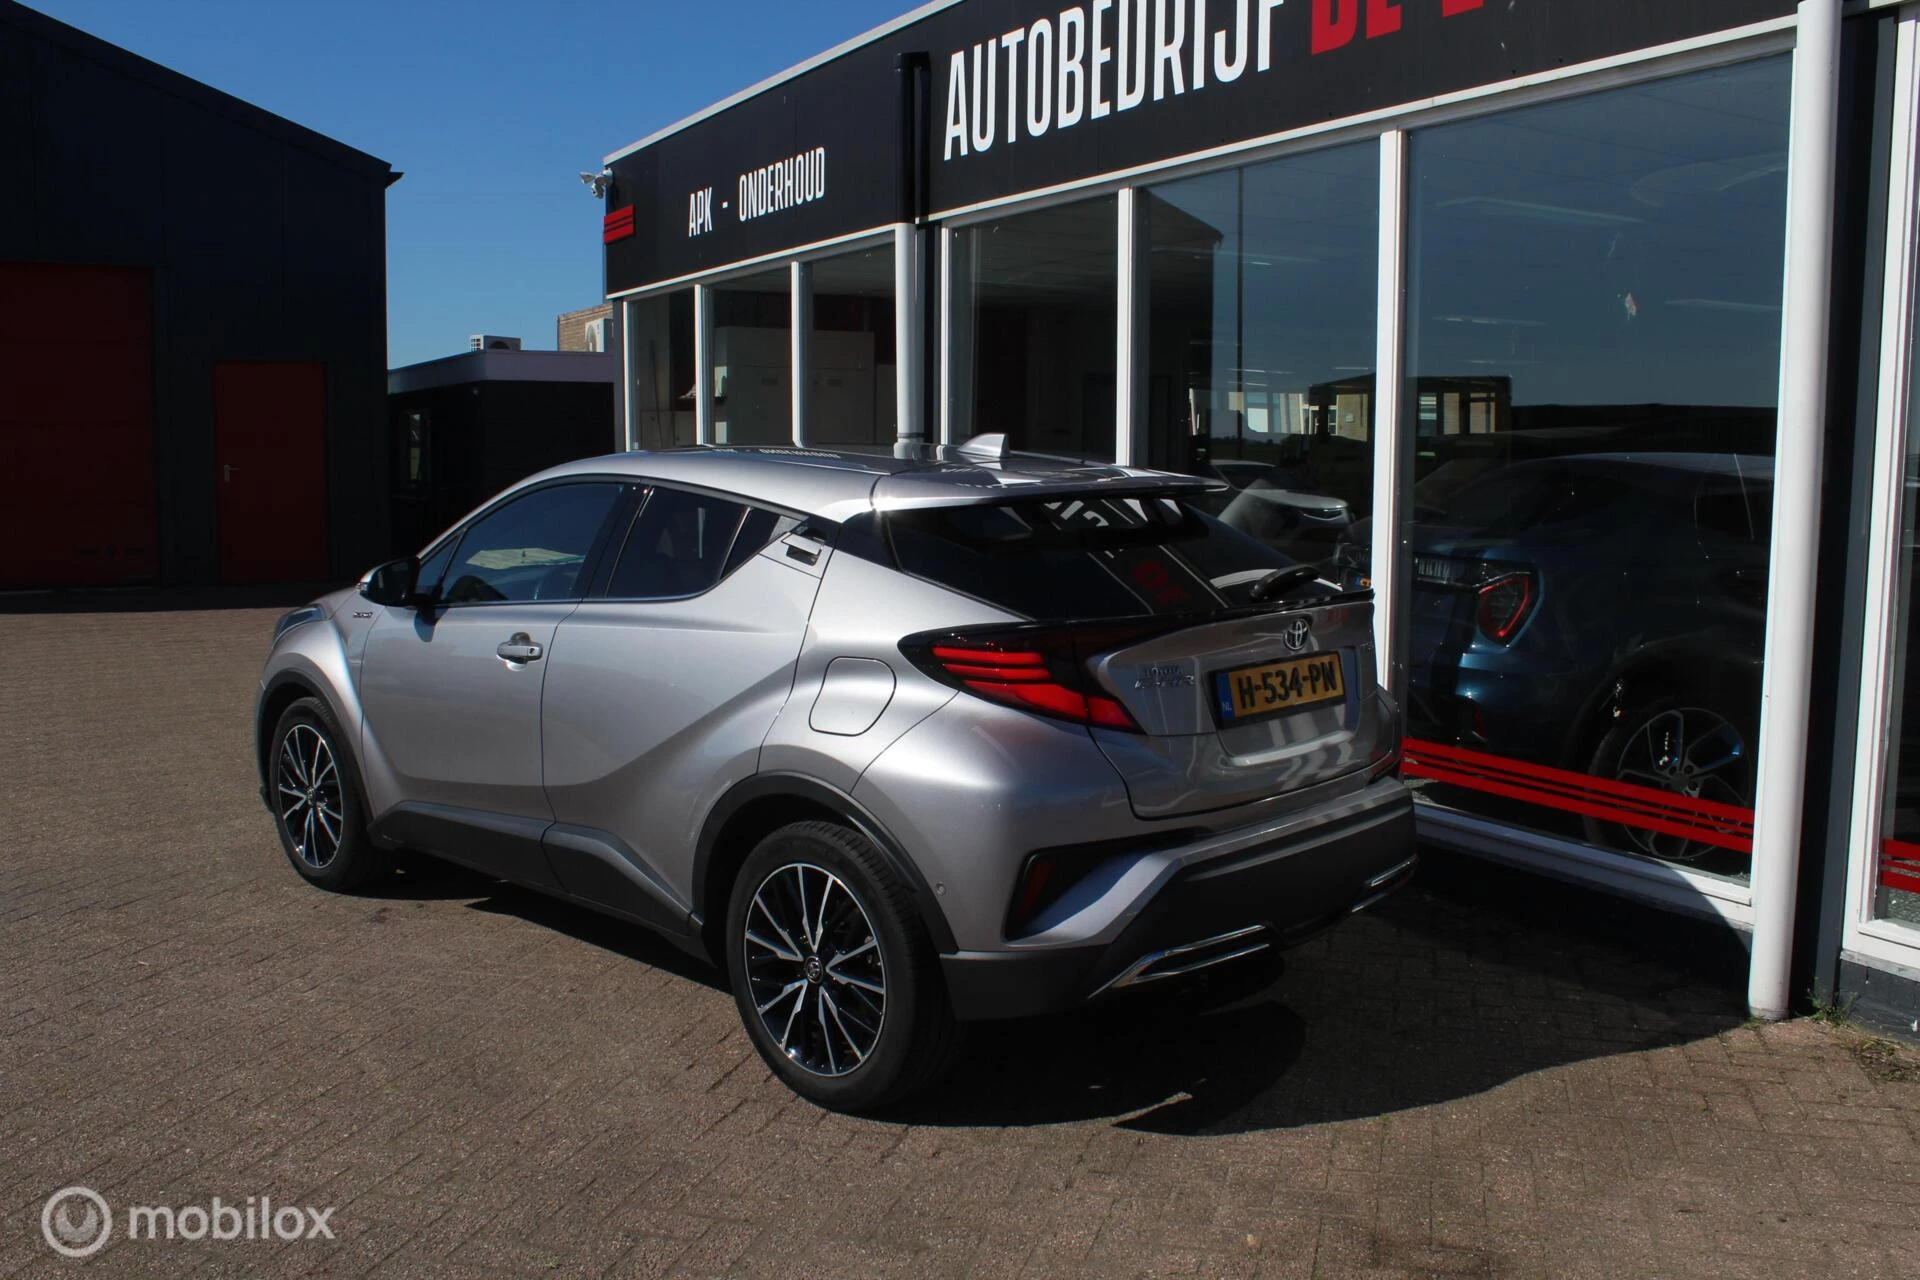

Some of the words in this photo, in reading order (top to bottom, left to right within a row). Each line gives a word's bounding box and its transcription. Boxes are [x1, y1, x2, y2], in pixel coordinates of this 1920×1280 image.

[943, 0, 1285, 161] AUTOBEDRIJF
[688, 186, 713, 238] APK
[738, 146, 826, 222] ONDERHOUD
[1237, 660, 1338, 710] H-534-PN
